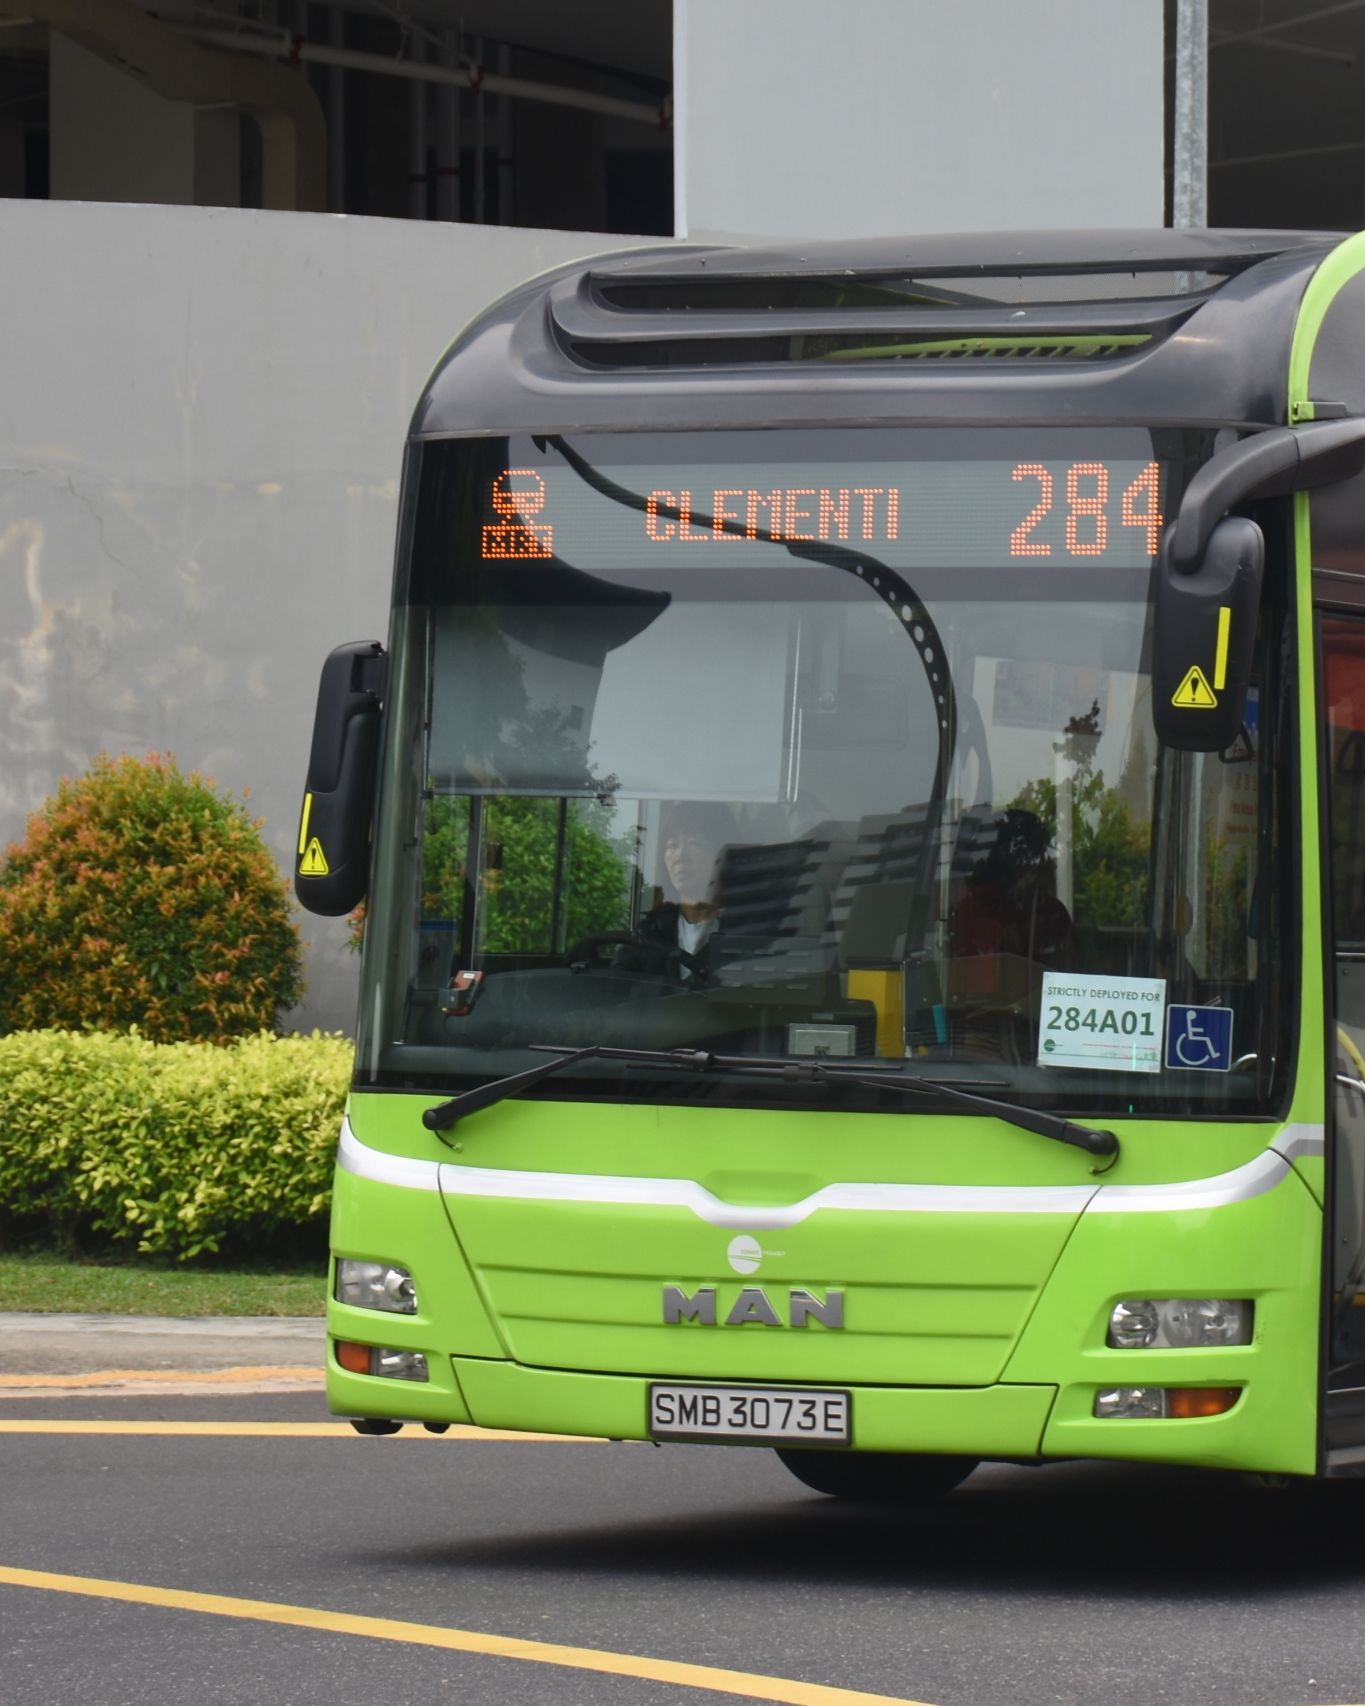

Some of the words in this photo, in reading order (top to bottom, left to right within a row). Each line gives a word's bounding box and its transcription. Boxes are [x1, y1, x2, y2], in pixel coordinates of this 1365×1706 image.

[646, 487, 899, 541] CLEMENTI
[1010, 462, 1162, 557] 284
[1047, 986, 1087, 999] STRICTLY
[1091, 989, 1138, 1001] DEPLOYED
[1141, 991, 1160, 1002] FOR
[1047, 1005, 1155, 1036] 284A01
[662, 1282, 846, 1330] MAN
[655, 1393, 845, 1433] SMB3073E
